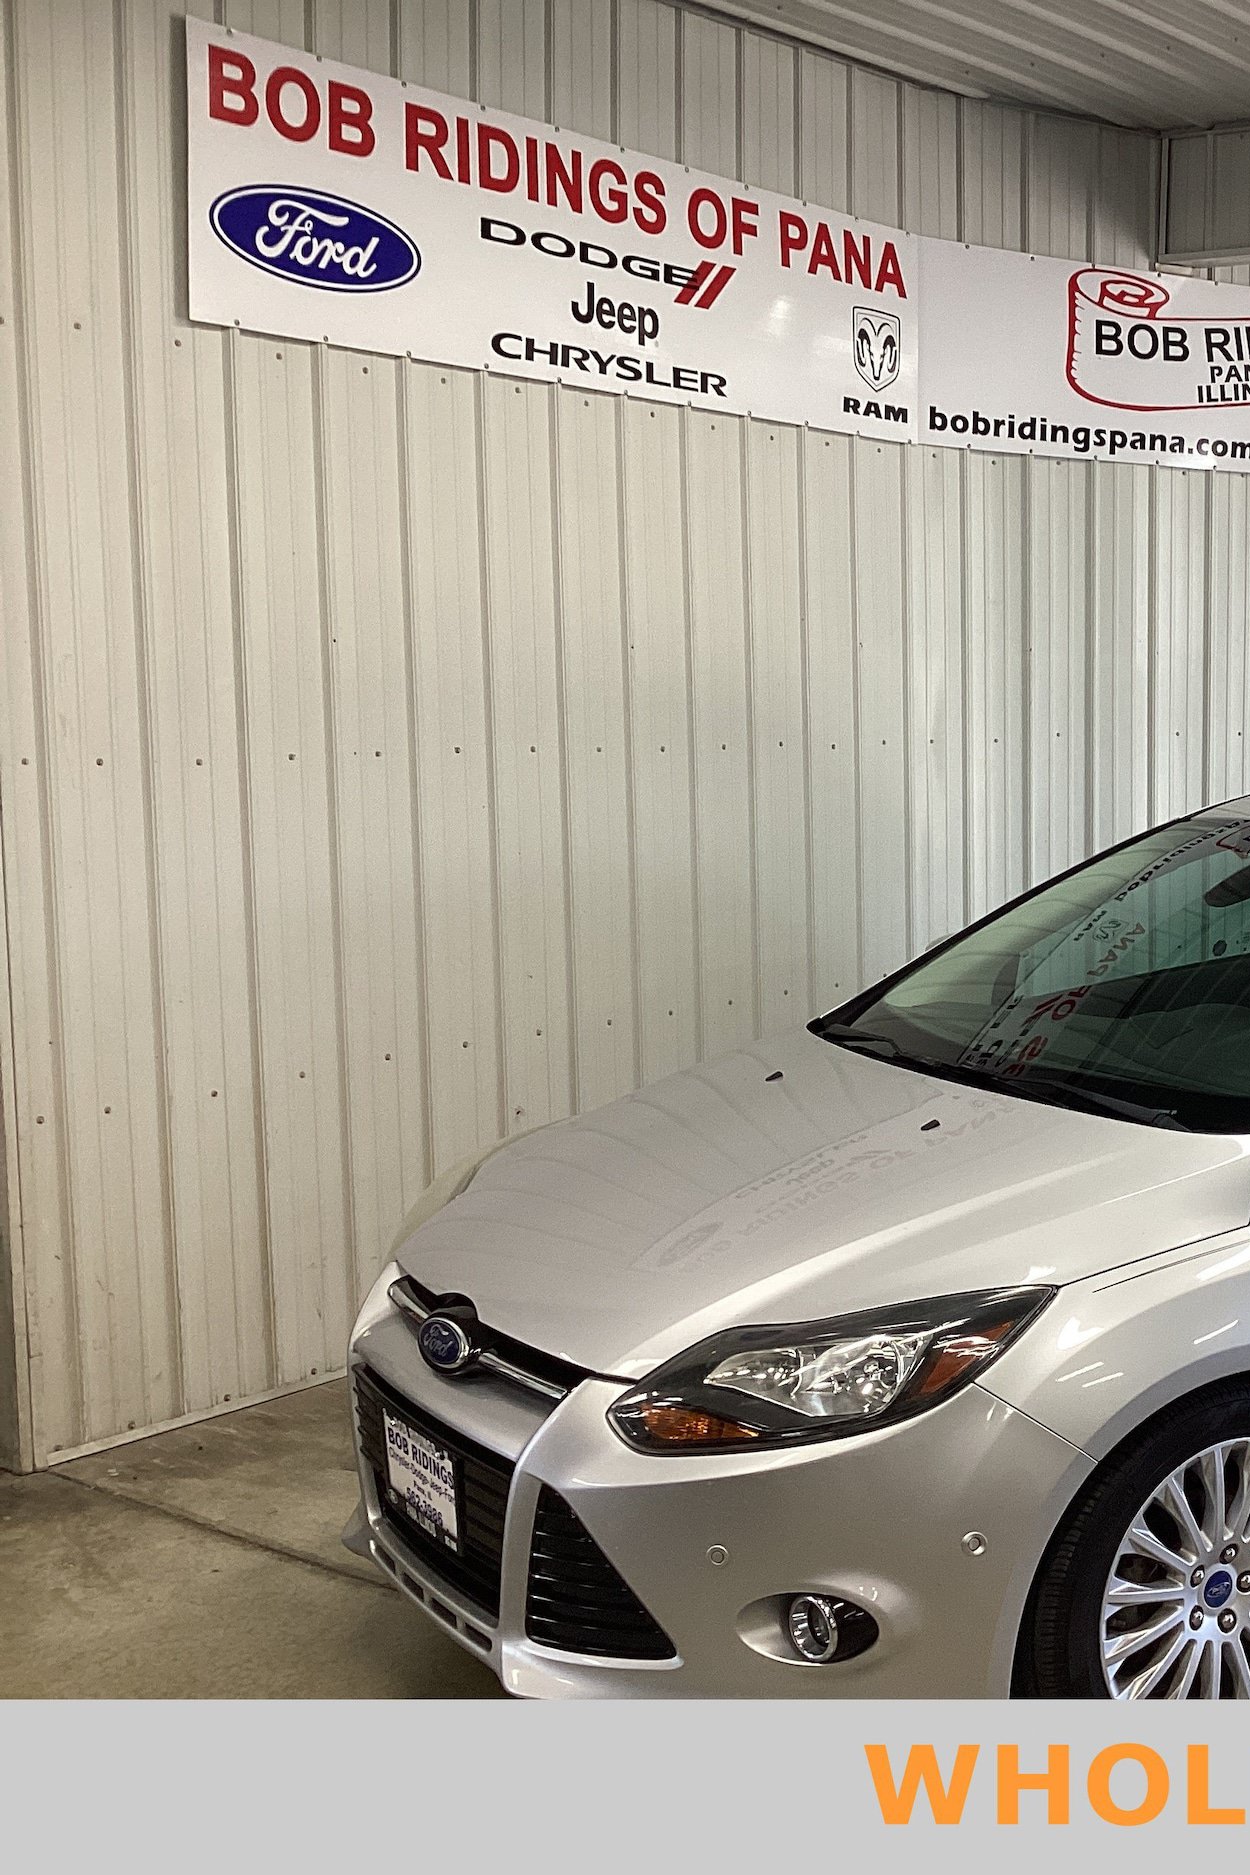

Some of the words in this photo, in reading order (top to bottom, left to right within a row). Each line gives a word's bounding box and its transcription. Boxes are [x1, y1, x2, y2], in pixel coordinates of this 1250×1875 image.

[208, 44, 376, 157] BOB
[405, 102, 668, 236] RIDINGS
[688, 187, 759, 257] OF
[779, 211, 908, 299] PANA
[254, 198, 378, 281] Ford
[480, 217, 701, 289] DODGE
[571, 281, 660, 345] Jeep
[1094, 319, 1190, 362] BOB
[491, 332, 727, 398] CHRYSLER
[843, 396, 908, 424] RAM
[387, 1426, 410, 1456] BOB
[411, 1443, 455, 1490] RIDINGS
